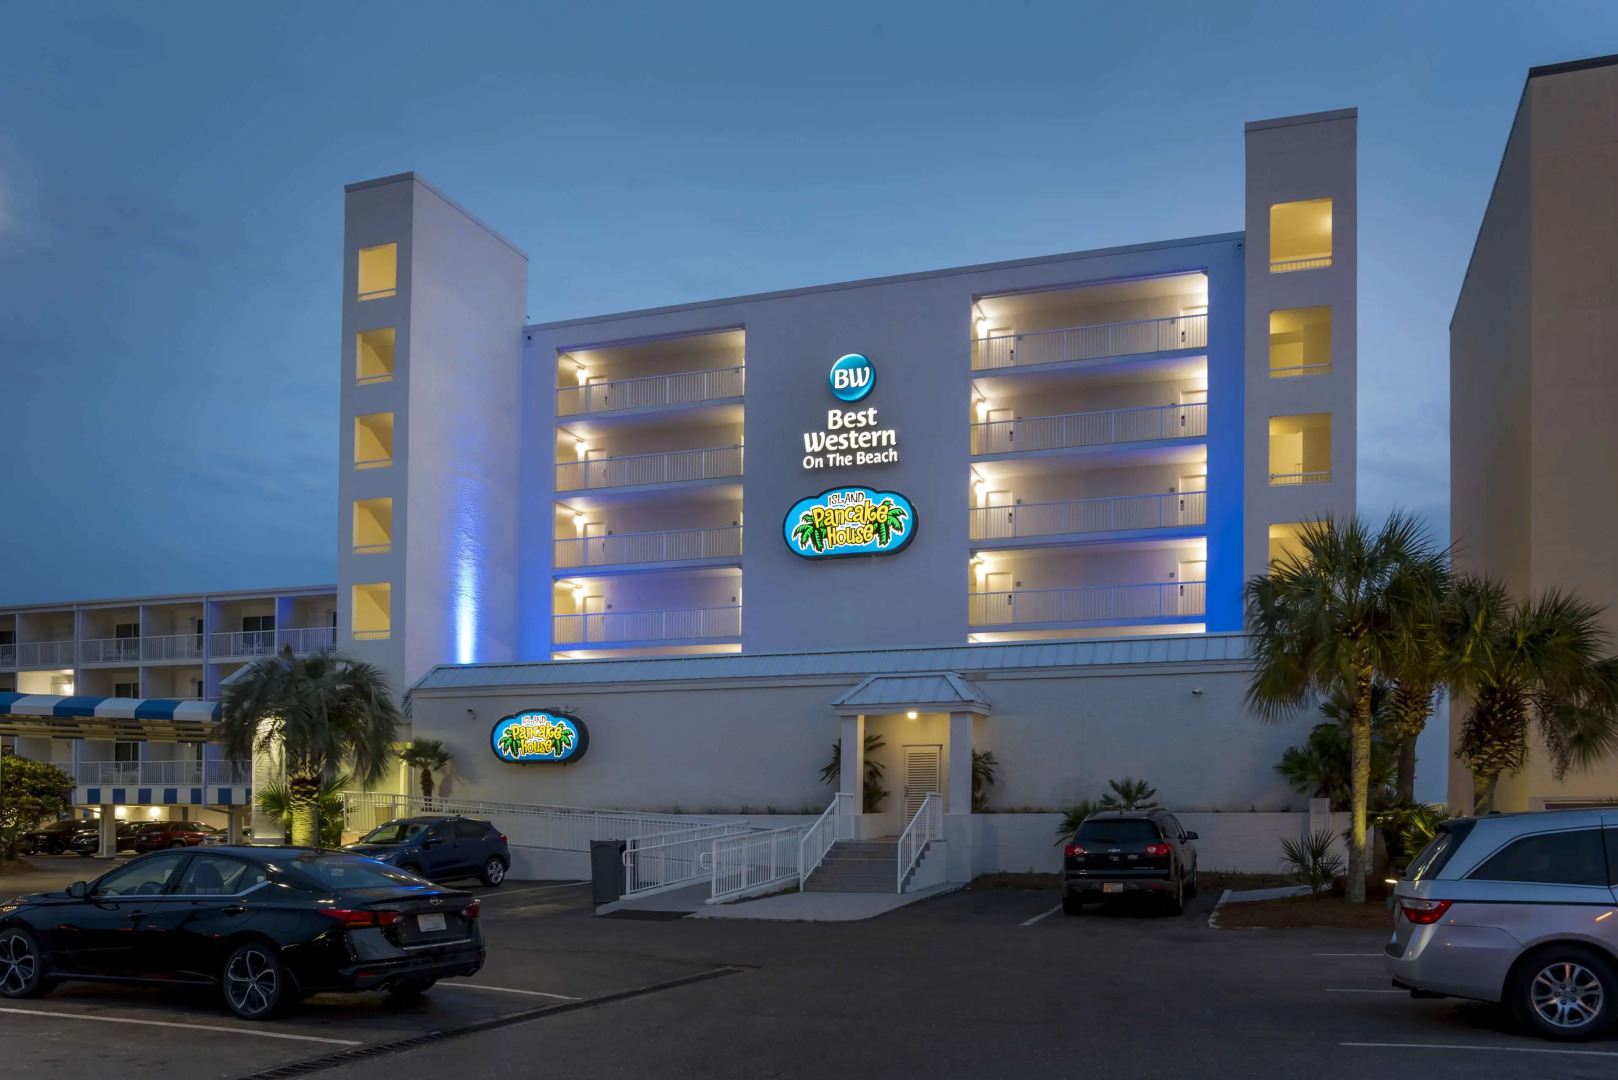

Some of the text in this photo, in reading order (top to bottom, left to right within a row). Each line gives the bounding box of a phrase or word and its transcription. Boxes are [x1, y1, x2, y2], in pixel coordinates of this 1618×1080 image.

[834, 367, 870, 389] BW
[827, 407, 878, 430] Best
[803, 429, 897, 453] Western
[802, 448, 898, 469] On The Beach
[828, 491, 865, 506] ISLAND
[811, 500, 890, 529] Pancake
[826, 522, 875, 548] House
[522, 716, 546, 724] ISLAND
[511, 722, 563, 740] Pancake
[520, 738, 553, 756] House
